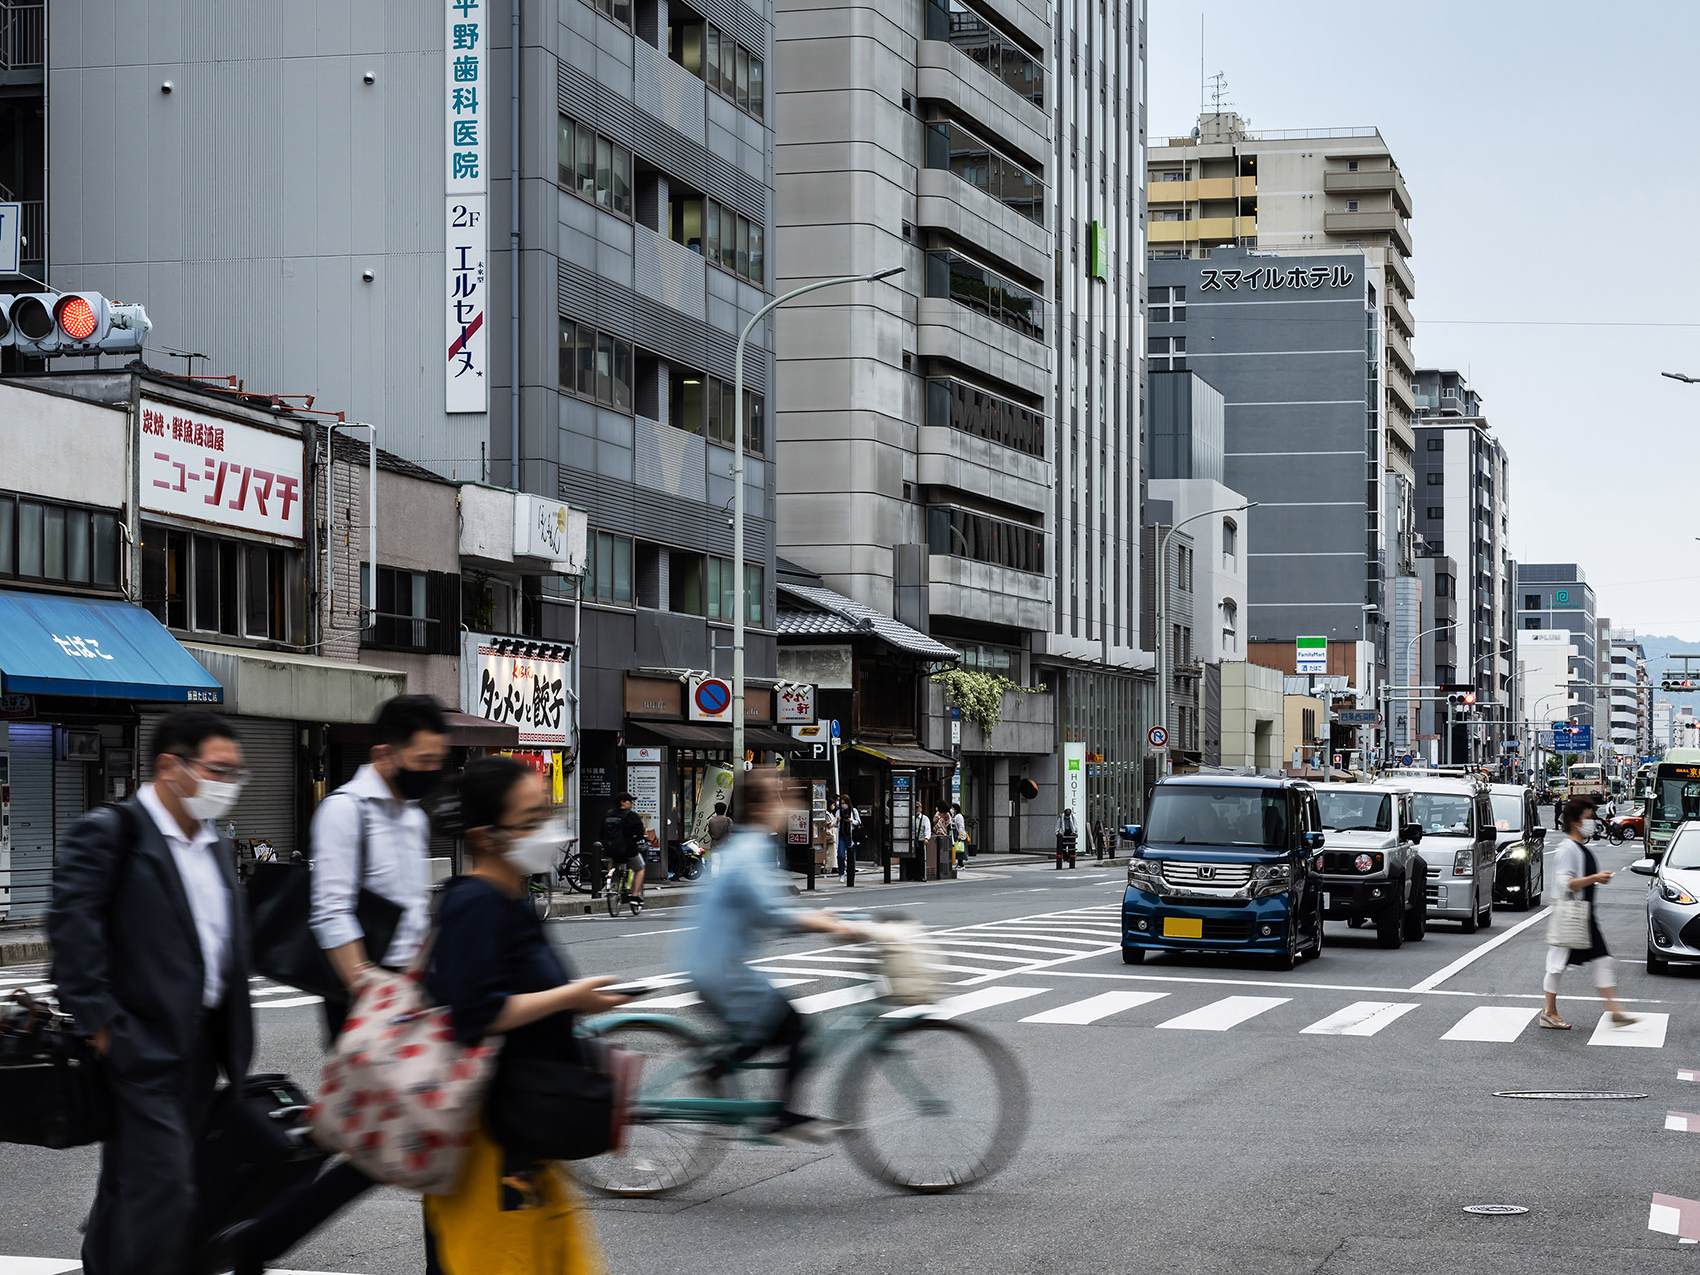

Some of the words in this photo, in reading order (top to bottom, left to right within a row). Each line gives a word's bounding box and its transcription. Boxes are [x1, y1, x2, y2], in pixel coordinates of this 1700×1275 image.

[452, 205, 480, 228] 2F
[1200, 264, 1354, 291] スマイルホテル
[451, 246, 477, 378] エルセーヌ
[142, 408, 225, 452] 炭焼・鮮魚居酒屋
[153, 451, 299, 521] ニューシンマチ
[51, 633, 114, 661] たばこ
[480, 668, 565, 729] タンメンと餃子
[796, 703, 810, 715] 軒
[813, 744, 824, 758] P
[789, 834, 800, 843] 24
